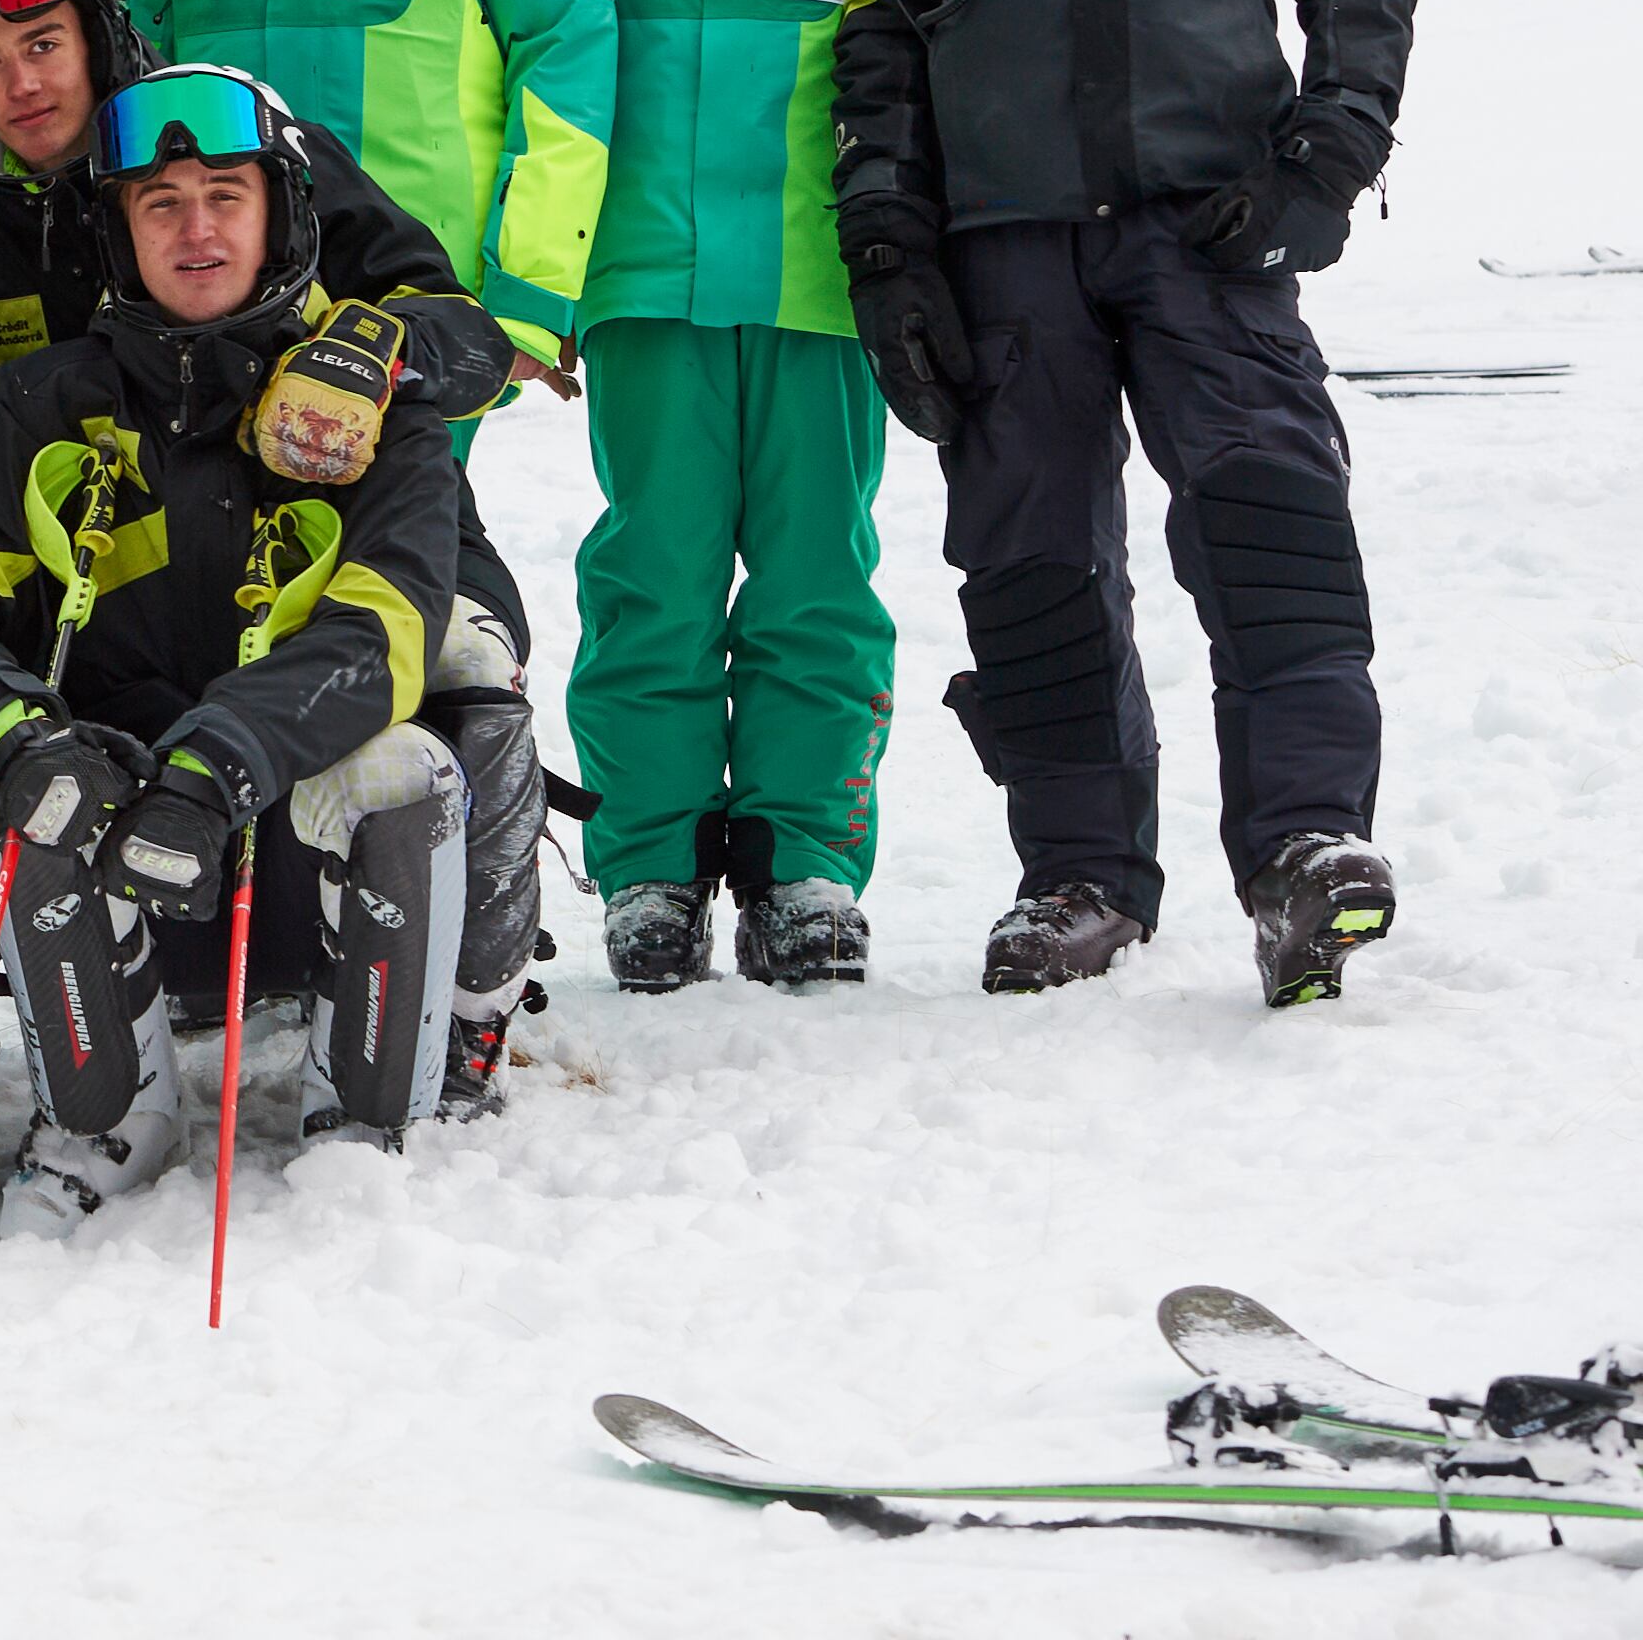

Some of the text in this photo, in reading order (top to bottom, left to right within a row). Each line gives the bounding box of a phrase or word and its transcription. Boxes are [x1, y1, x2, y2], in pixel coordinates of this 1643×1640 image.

[311, 350, 375, 383] LEVEL
[34, 785, 70, 840] LEKI
[126, 844, 190, 876] LEKI
[60, 961, 94, 1053] ENERGIAPURA
[237, 940, 249, 1023] CARBON
[364, 966, 383, 1065] ENERGIAPURA
